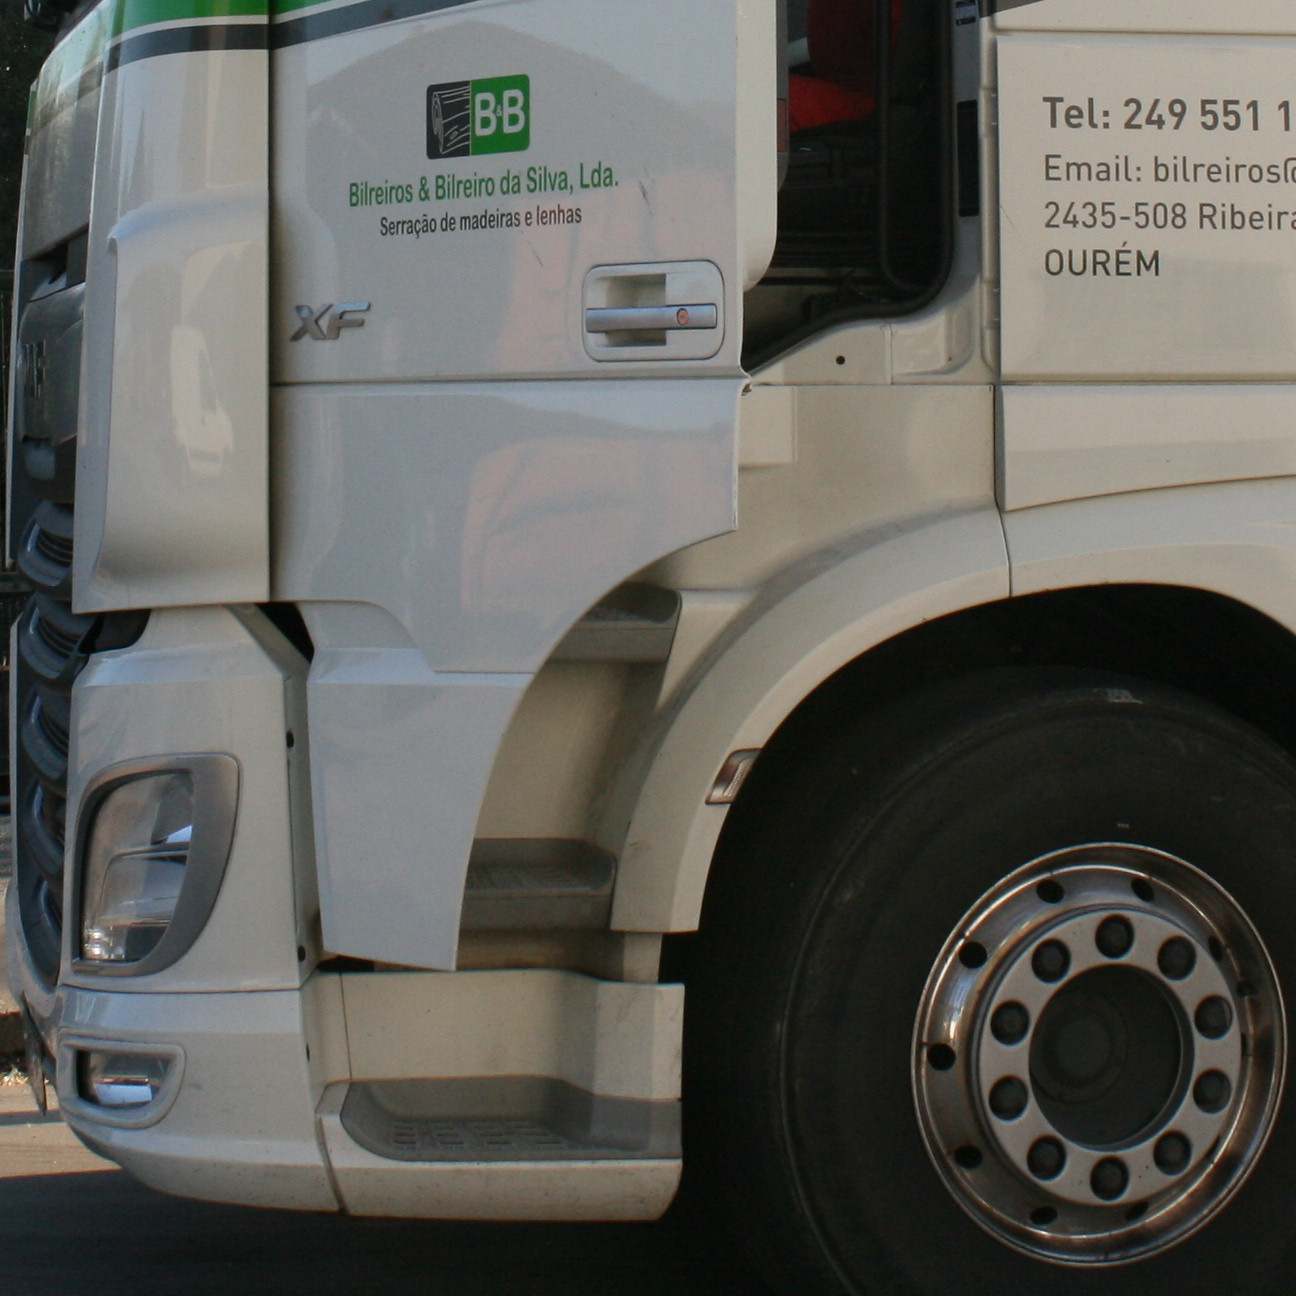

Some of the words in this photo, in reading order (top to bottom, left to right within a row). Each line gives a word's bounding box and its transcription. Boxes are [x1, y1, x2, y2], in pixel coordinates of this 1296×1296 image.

[1043, 97, 1110, 129] Tel:
[1123, 98, 1187, 130] 249
[1200, 99, 1261, 132] 551
[349, 179, 413, 207] Bilreiros
[418, 176, 430, 202] &
[435, 172, 495, 201] Bilreiro
[500, 169, 521, 195] da
[526, 165, 574, 195] Silva,
[579, 161, 619, 189] Lda.
[1044, 154, 1142, 183] Email:
[380, 213, 437, 239] Serração
[440, 212, 456, 232] de
[459, 208, 521, 231] madeiras
[525, 211, 533, 227] e
[536, 204, 582, 226] lenhas
[1044, 201, 1188, 230] 2435-508
[1044, 241, 1161, 277] OURÉM
[290, 302, 371, 341] XF
